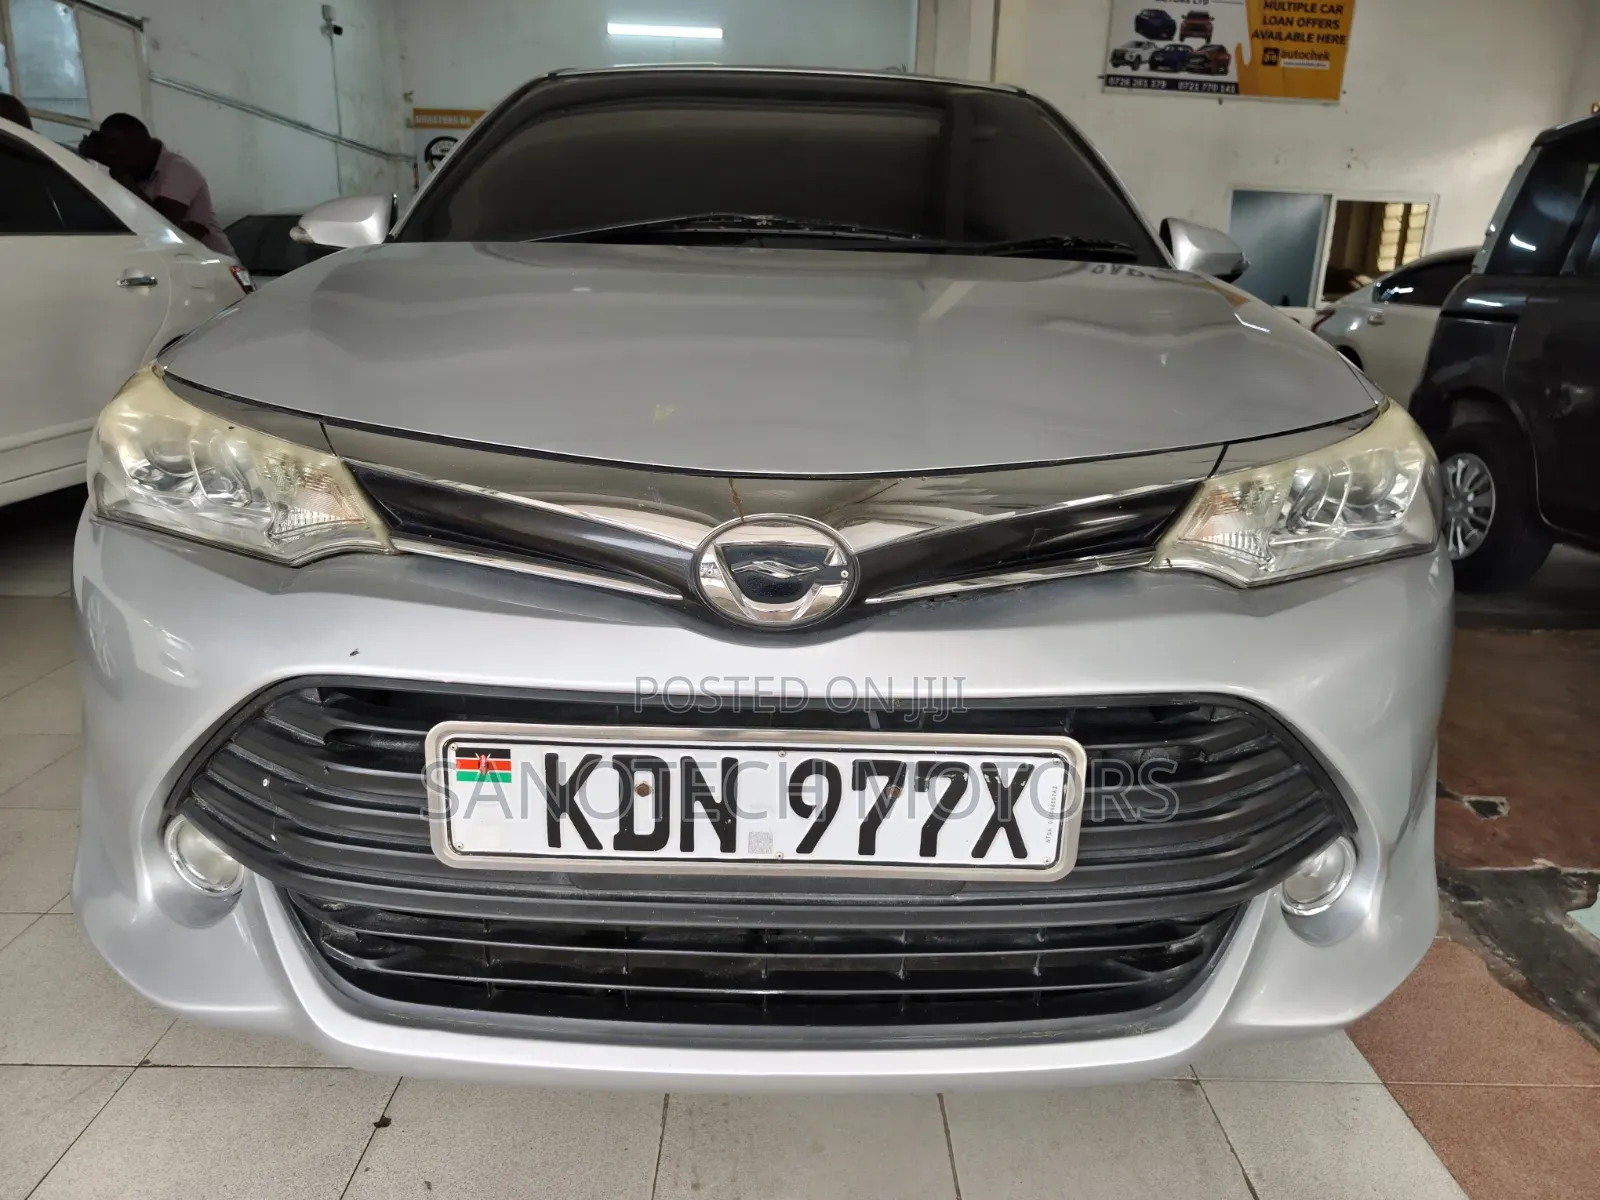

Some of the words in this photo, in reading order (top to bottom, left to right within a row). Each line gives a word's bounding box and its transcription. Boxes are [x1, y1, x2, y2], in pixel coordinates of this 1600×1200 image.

[1263, 0, 1317, 13] MULTIPLE
[1320, 4, 1344, 15] CAR
[1263, 16, 1294, 26] LOAN
[1297, 18, 1340, 29] OFFERS
[1251, 30, 1315, 43] AVAILABLE
[1316, 34, 1347, 44] HERE
[544, 752, 739, 852] KDN
[788, 758, 1035, 859] 977X
